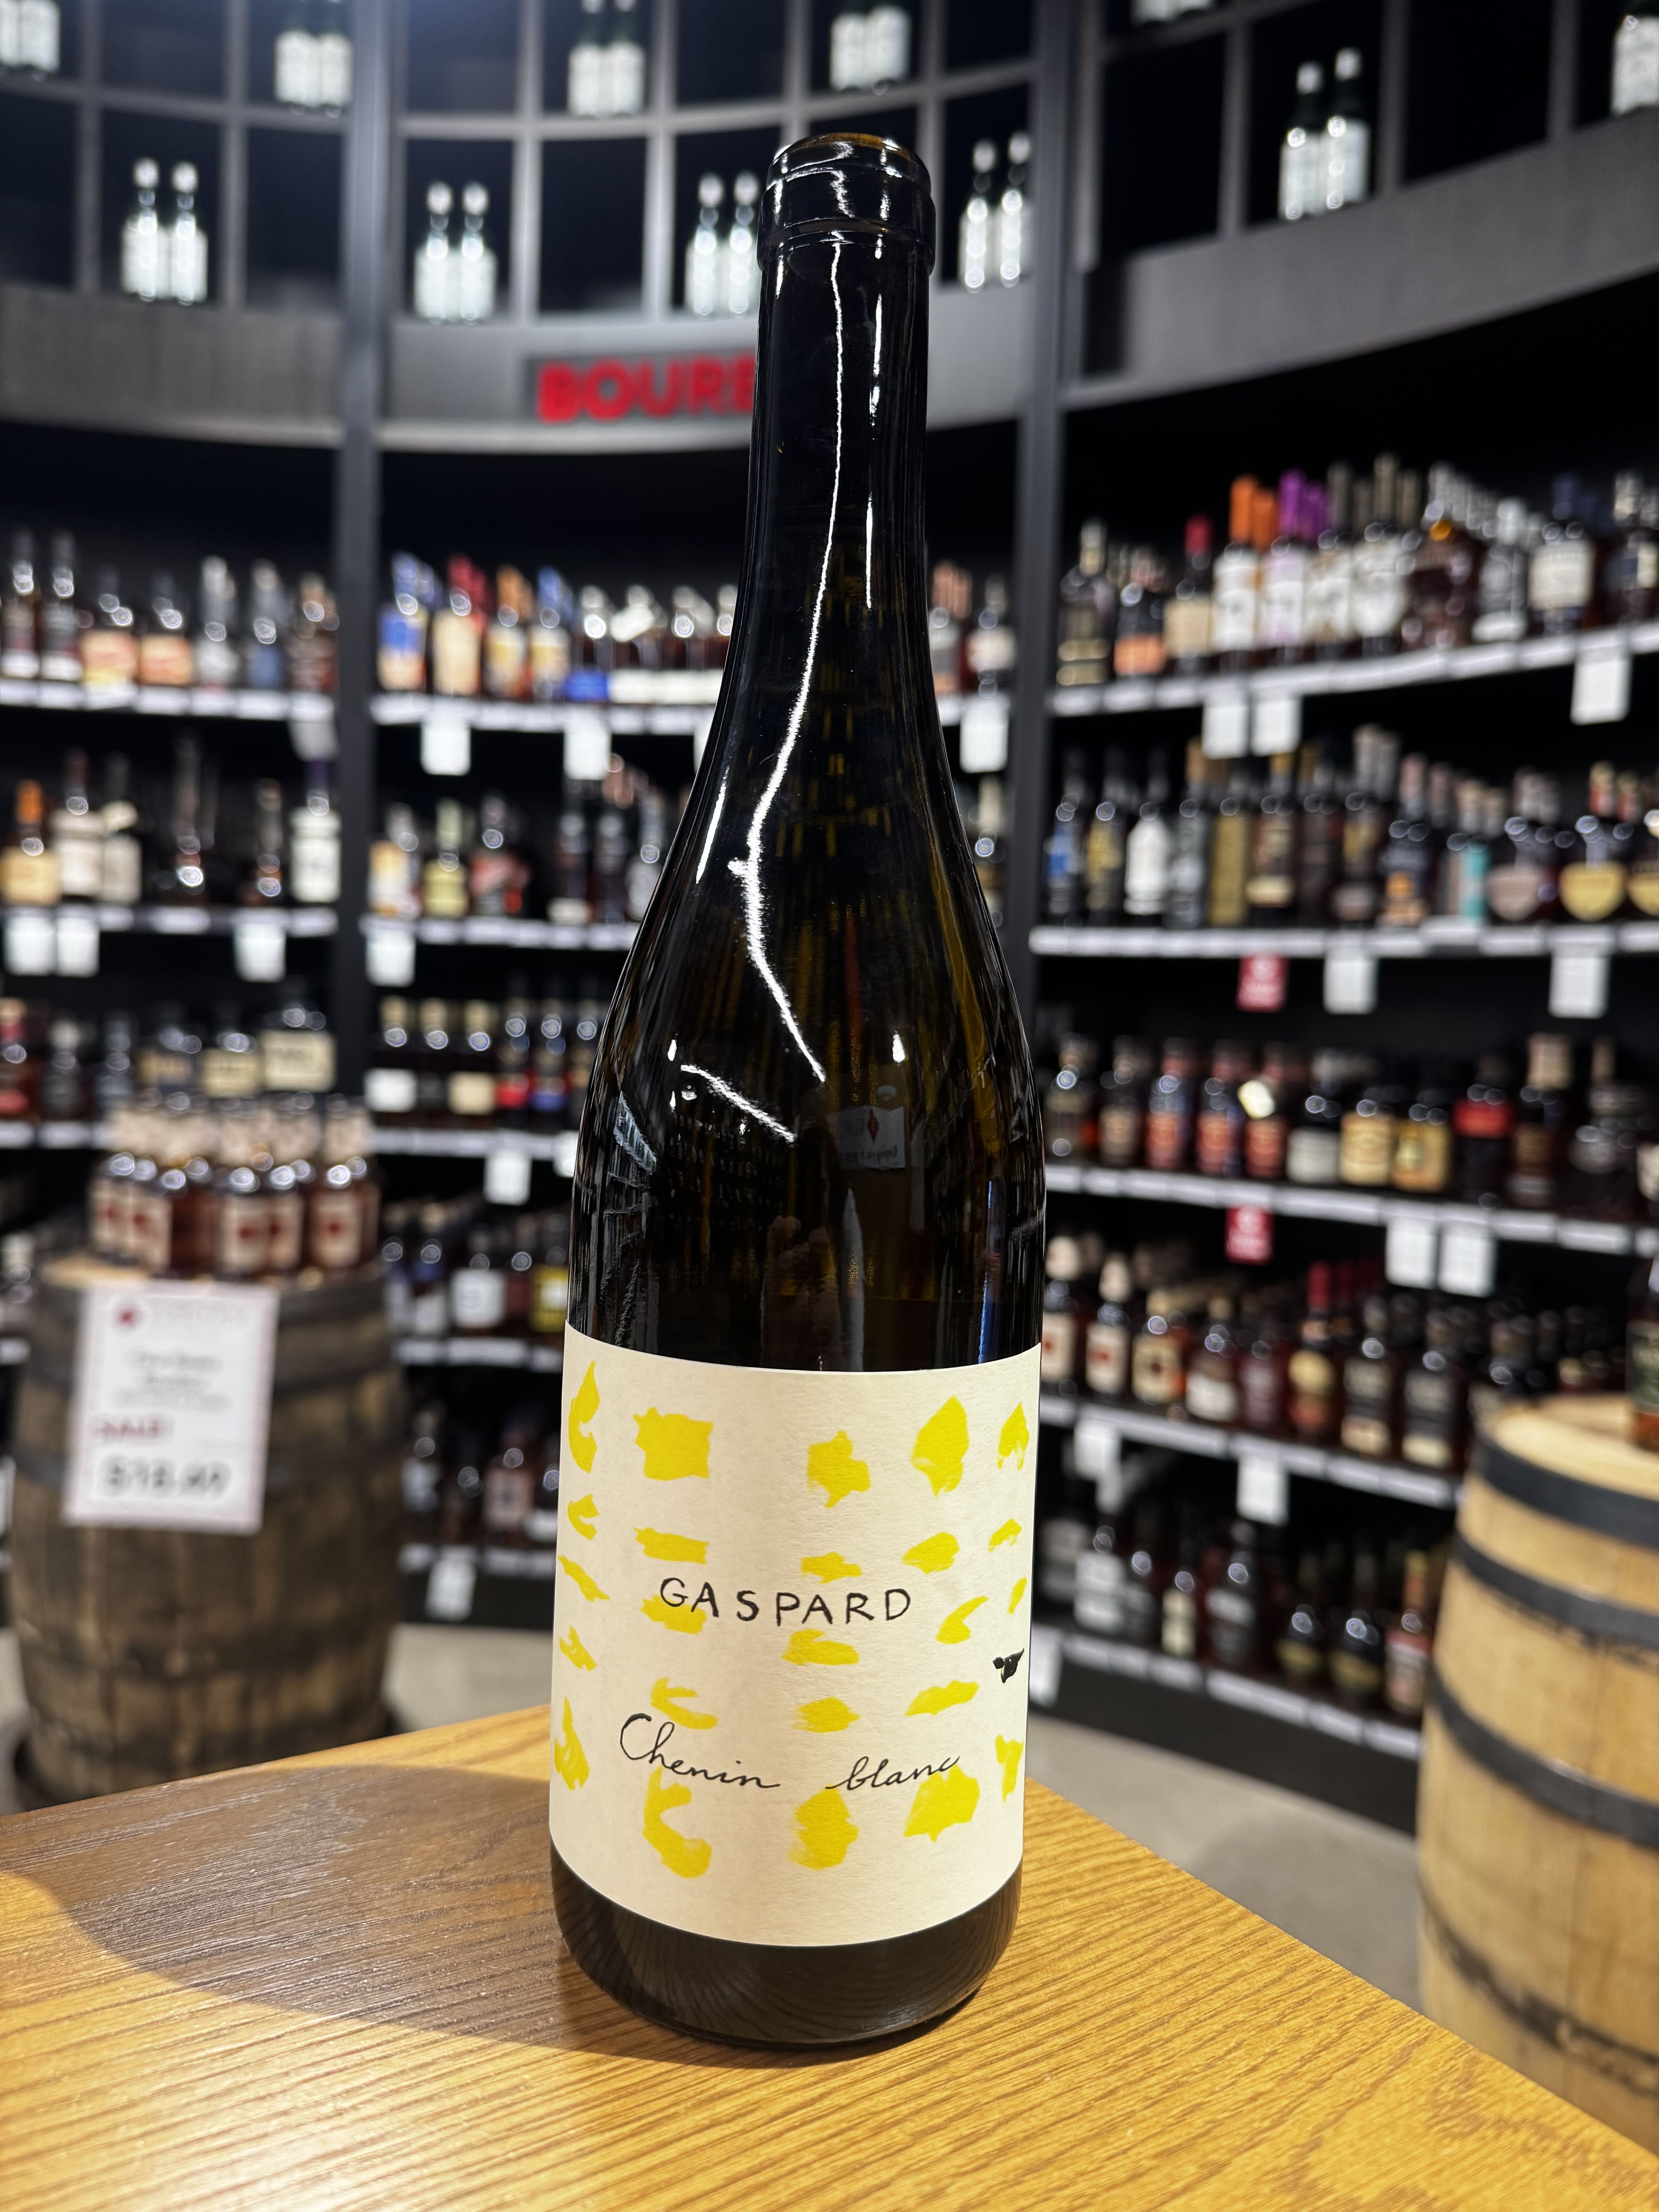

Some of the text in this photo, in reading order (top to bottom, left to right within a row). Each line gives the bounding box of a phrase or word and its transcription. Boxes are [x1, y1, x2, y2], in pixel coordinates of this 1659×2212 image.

[660, 1577, 911, 1626] GASPARD
[620, 1713, 960, 1791] Chenin blanc
